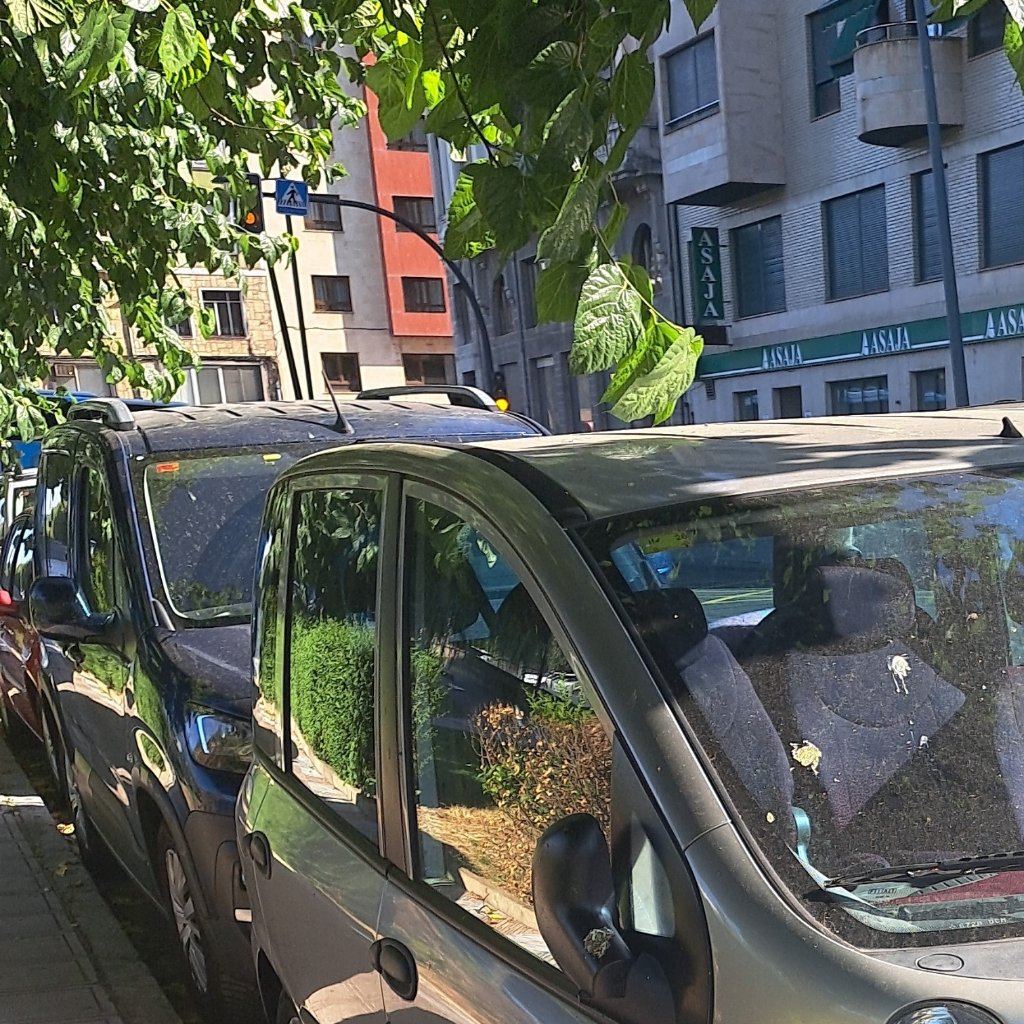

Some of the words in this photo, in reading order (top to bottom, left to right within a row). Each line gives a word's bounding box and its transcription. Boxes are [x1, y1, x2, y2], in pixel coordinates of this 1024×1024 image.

[698, 230, 719, 317] ASAJA
[870, 327, 911, 354] ASAJA
[769, 343, 803, 368] ASAJA
